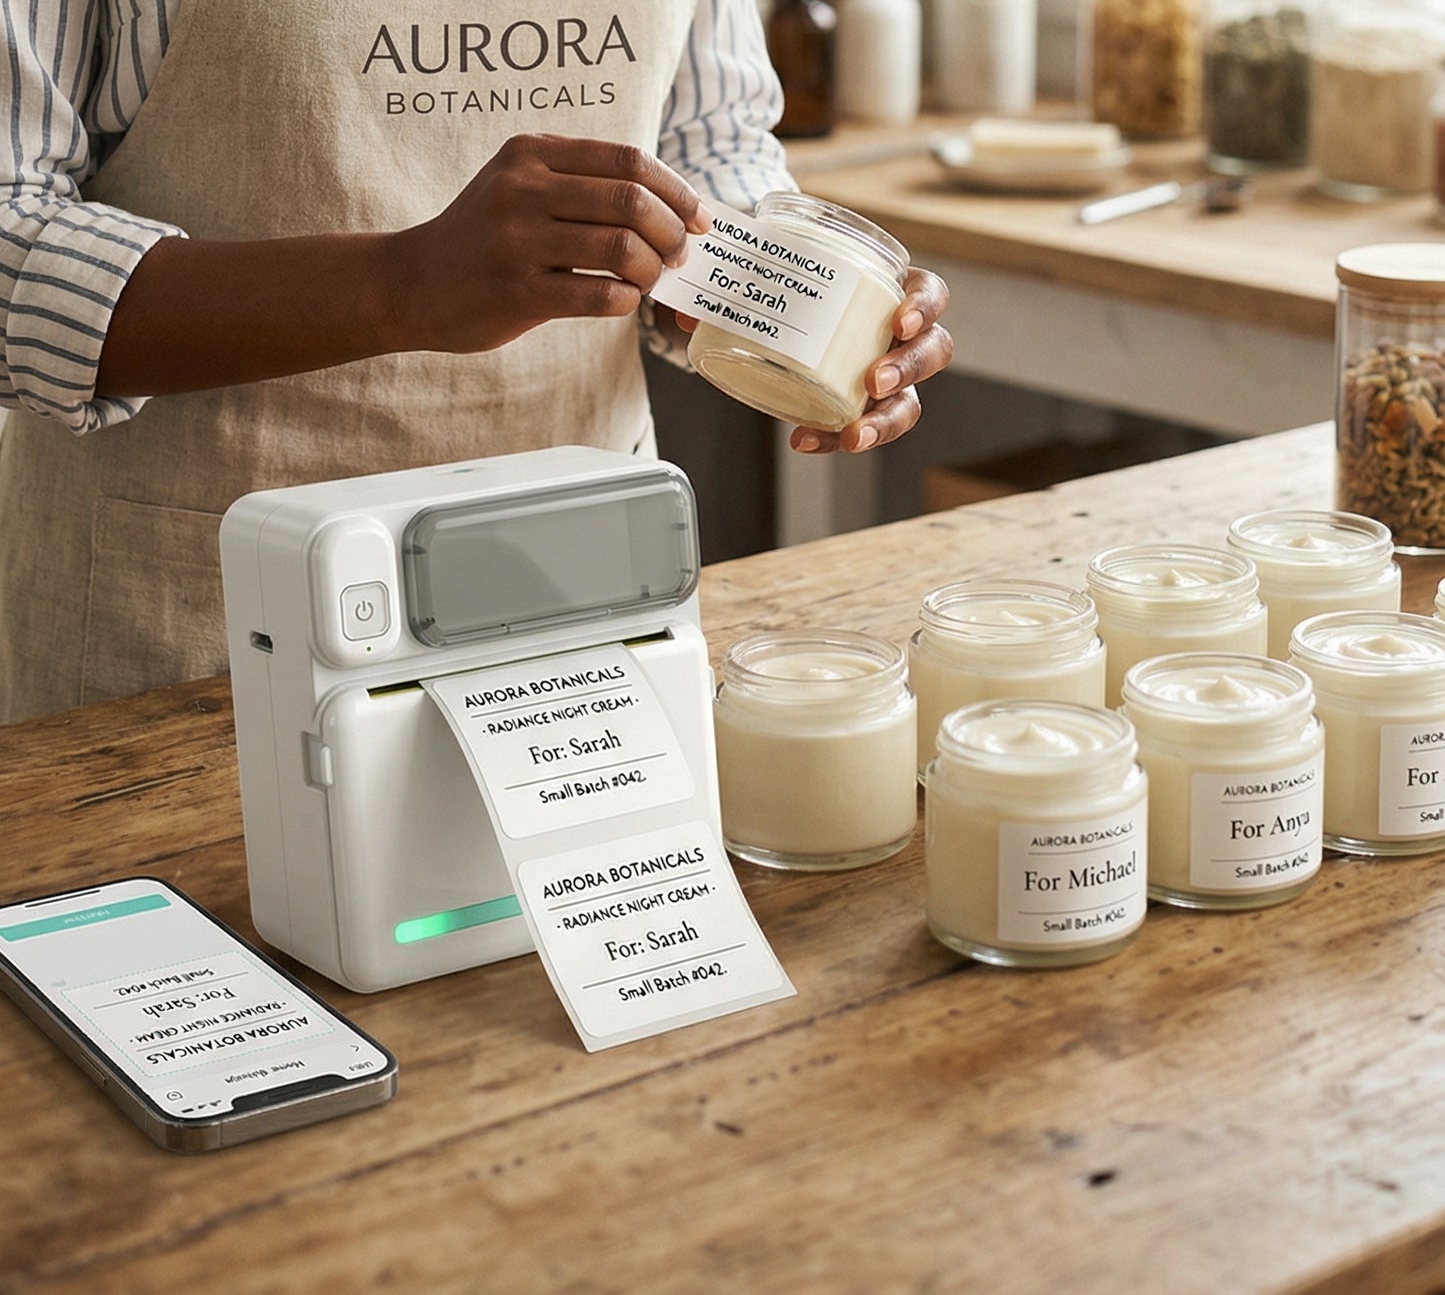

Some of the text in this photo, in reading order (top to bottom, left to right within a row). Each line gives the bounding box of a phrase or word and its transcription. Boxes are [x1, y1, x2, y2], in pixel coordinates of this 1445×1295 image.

[362, 14, 637, 75] AURORA
[386, 82, 616, 115] BOTANICALS
[761, 240, 836, 281] BOTANICALS
[708, 267, 788, 313] For: Sarah
[464, 665, 625, 708] AURORA BOTANICALS
[487, 696, 634, 735] RADIANCE NIGHT CREAM
[528, 729, 622, 765] For: Sarah
[539, 783, 574, 804] Small
[574, 776, 610, 797] Batch
[1223, 786, 1267, 796] AURORA
[1407, 767, 1439, 786] For
[1031, 836, 1077, 846] AURORA
[1230, 820, 1265, 839] For
[543, 847, 705, 899] AURORA BOTANICALS
[1024, 850, 1136, 891] For Michael
[1235, 864, 1263, 878] Small
[562, 884, 710, 930] RADIANCE NIGHT CREAM
[1043, 918, 1072, 932] Small
[604, 920, 700, 961] For: Sarah
[142, 987, 237, 1018] For: Sarah
[619, 980, 654, 1001] Small
[654, 970, 691, 992] Batch
[146, 1016, 309, 1065] AURORA BOTANICALS
